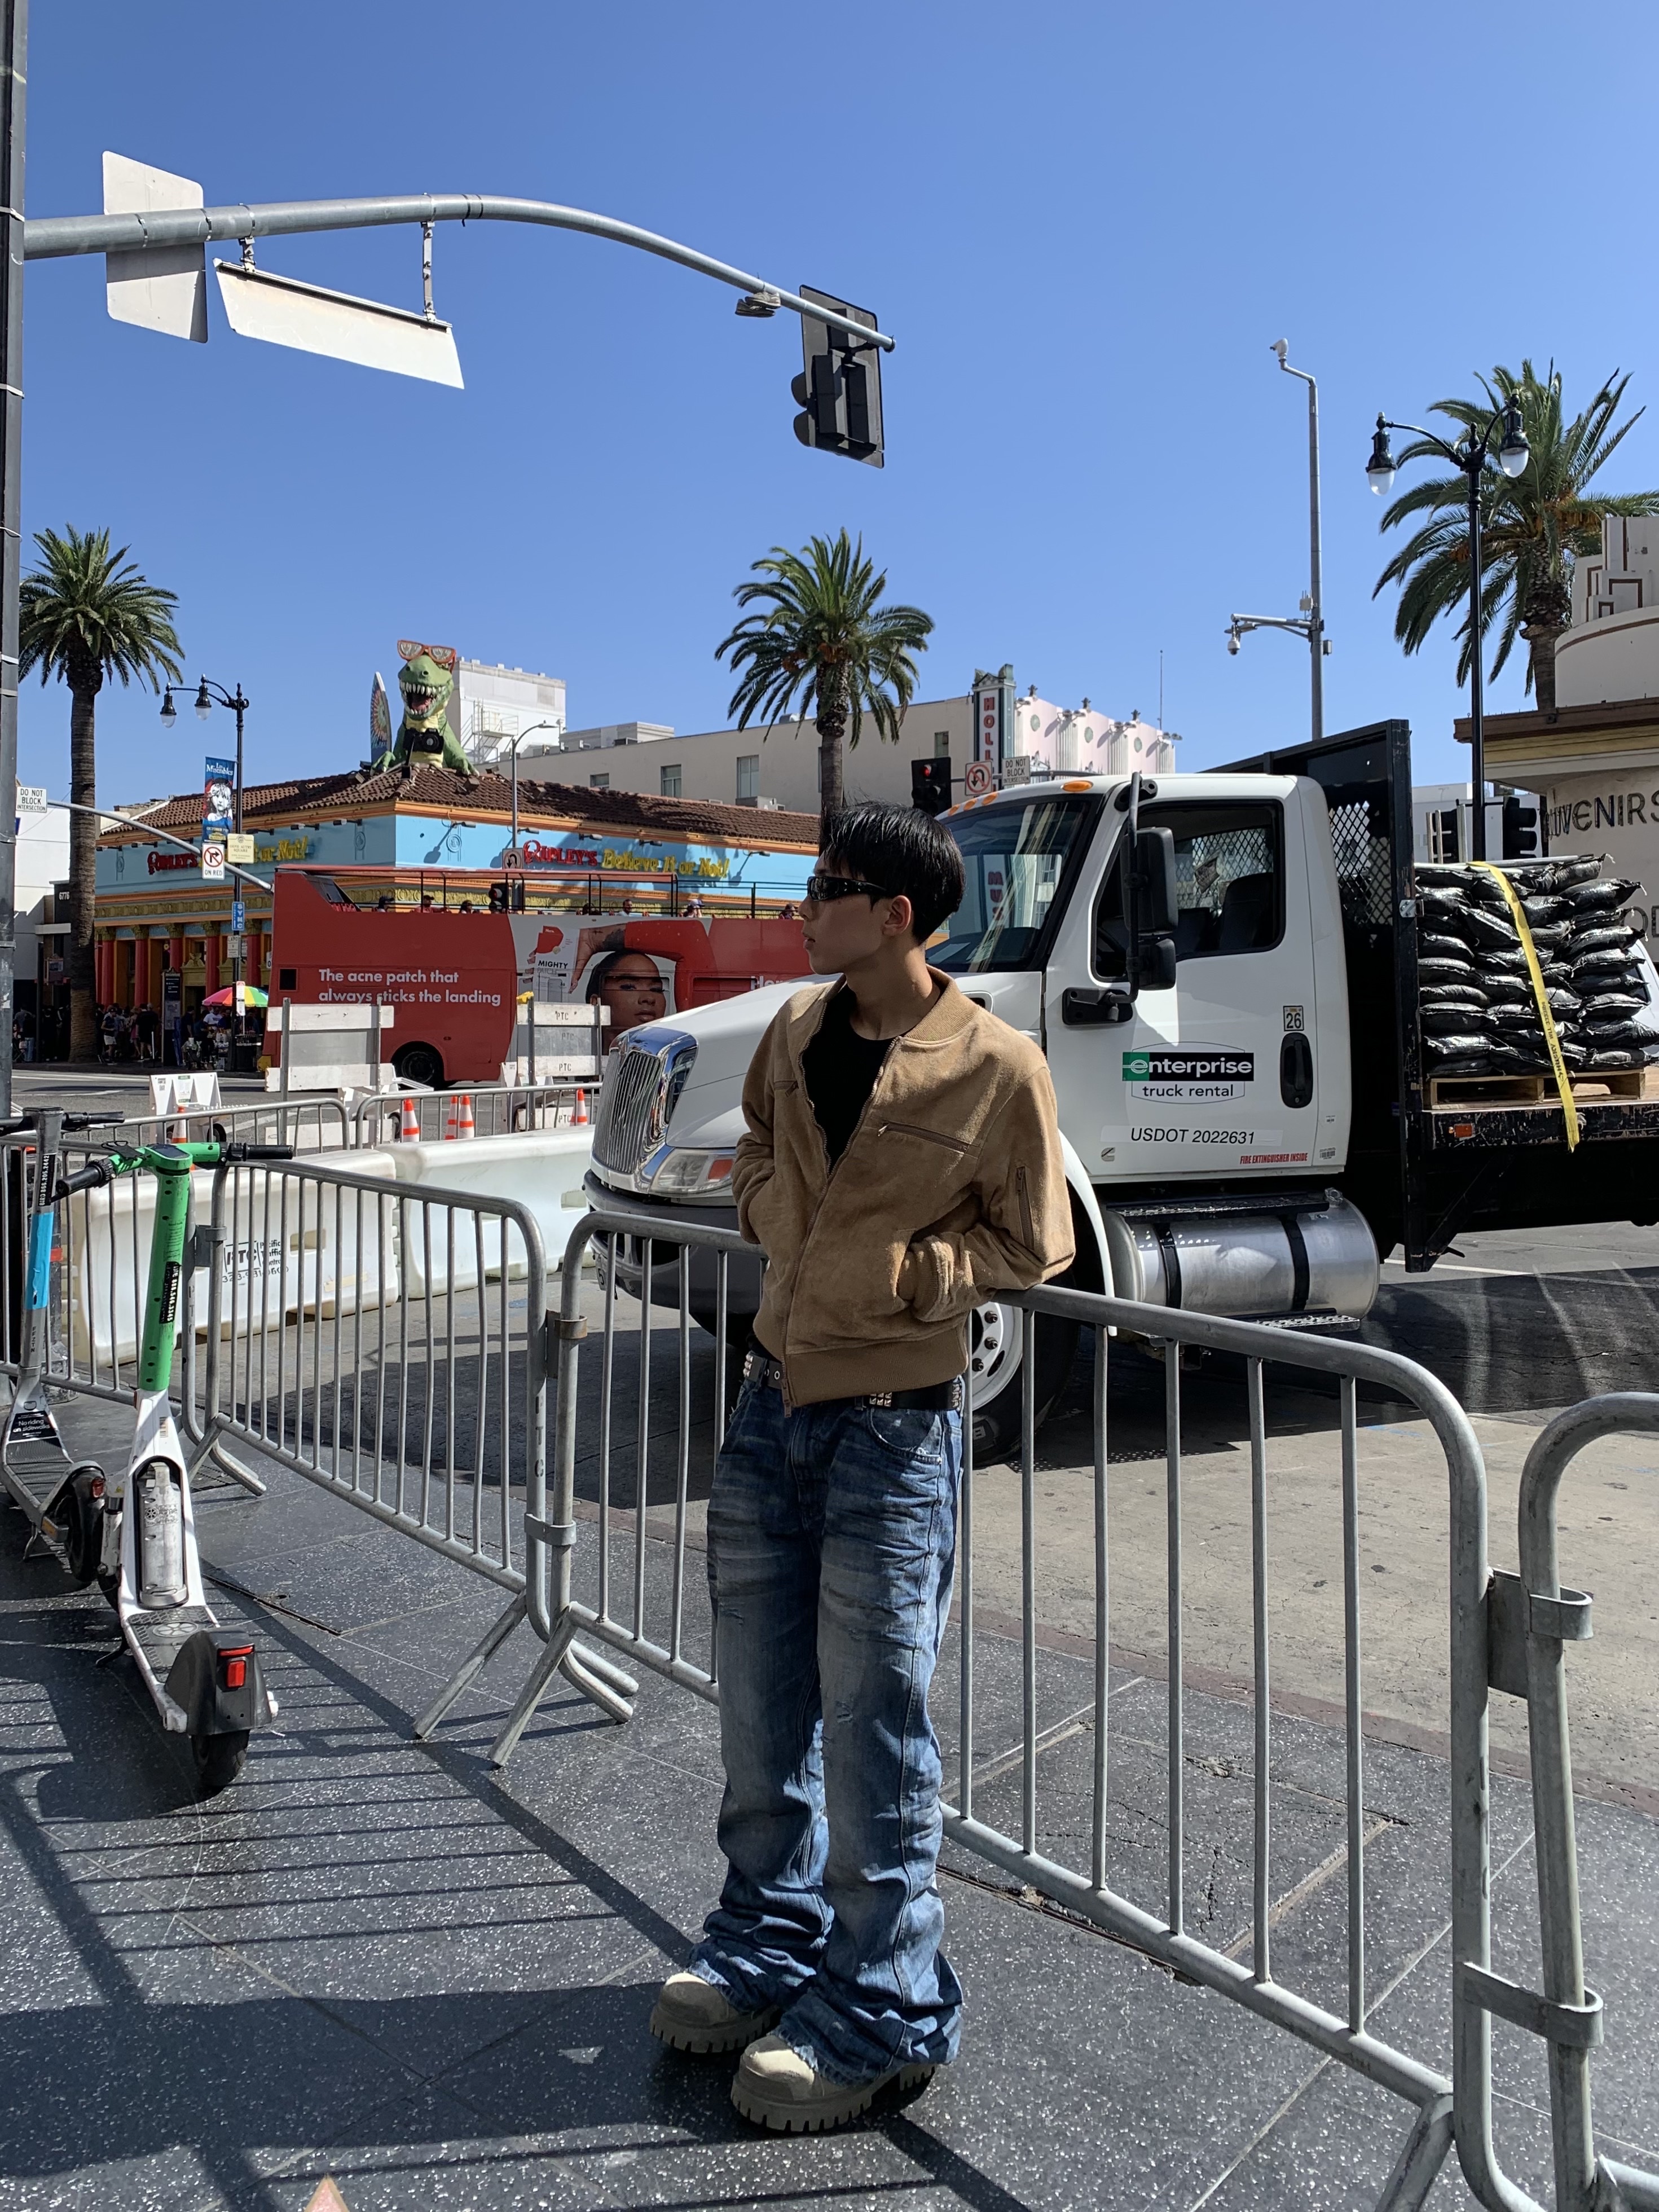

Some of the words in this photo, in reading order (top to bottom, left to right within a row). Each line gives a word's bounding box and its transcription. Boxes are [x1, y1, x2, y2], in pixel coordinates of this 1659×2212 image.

[984, 697, 996, 774] HOLL
[1015, 758, 1026, 767] NOT
[1007, 768, 1025, 776] BLOCK
[21, 797, 41, 805] BLOCK
[276, 835, 308, 861] Not!
[523, 839, 598, 866] RIPLEY'S
[601, 848, 659, 871] Believe
[663, 856, 676, 873] It
[679, 861, 694, 875] or
[697, 857, 730, 878] Not!
[59, 891, 70, 900] 6776
[538, 960, 568, 969] MIGHTY
[319, 968, 344, 982] The
[347, 972, 382, 983] acne
[386, 970, 426, 986] patch
[430, 970, 459, 983] that
[319, 988, 372, 1004] always
[377, 989, 416, 1002] sticks
[419, 989, 441, 1002] the
[445, 989, 501, 1006] landing
[556, 1012, 569, 1021] PTC
[1286, 1013, 1301, 1029] 26
[1551, 1044, 1562, 1071] HUSKY
[559, 1063, 571, 1071] PTC
[1130, 1057, 1252, 1078] enterprise
[1142, 1084, 1183, 1097] truck
[1189, 1084, 1233, 1097] rental
[558, 1114, 571, 1124] PTC
[1130, 1127, 1189, 1142] USDOT
[1191, 1130, 1255, 1144] 2022631
[1240, 1155, 1251, 1164] FIRE
[1252, 1154, 1290, 1164] EXTINGUISHER
[1290, 1153, 1308, 1162] INSIDE
